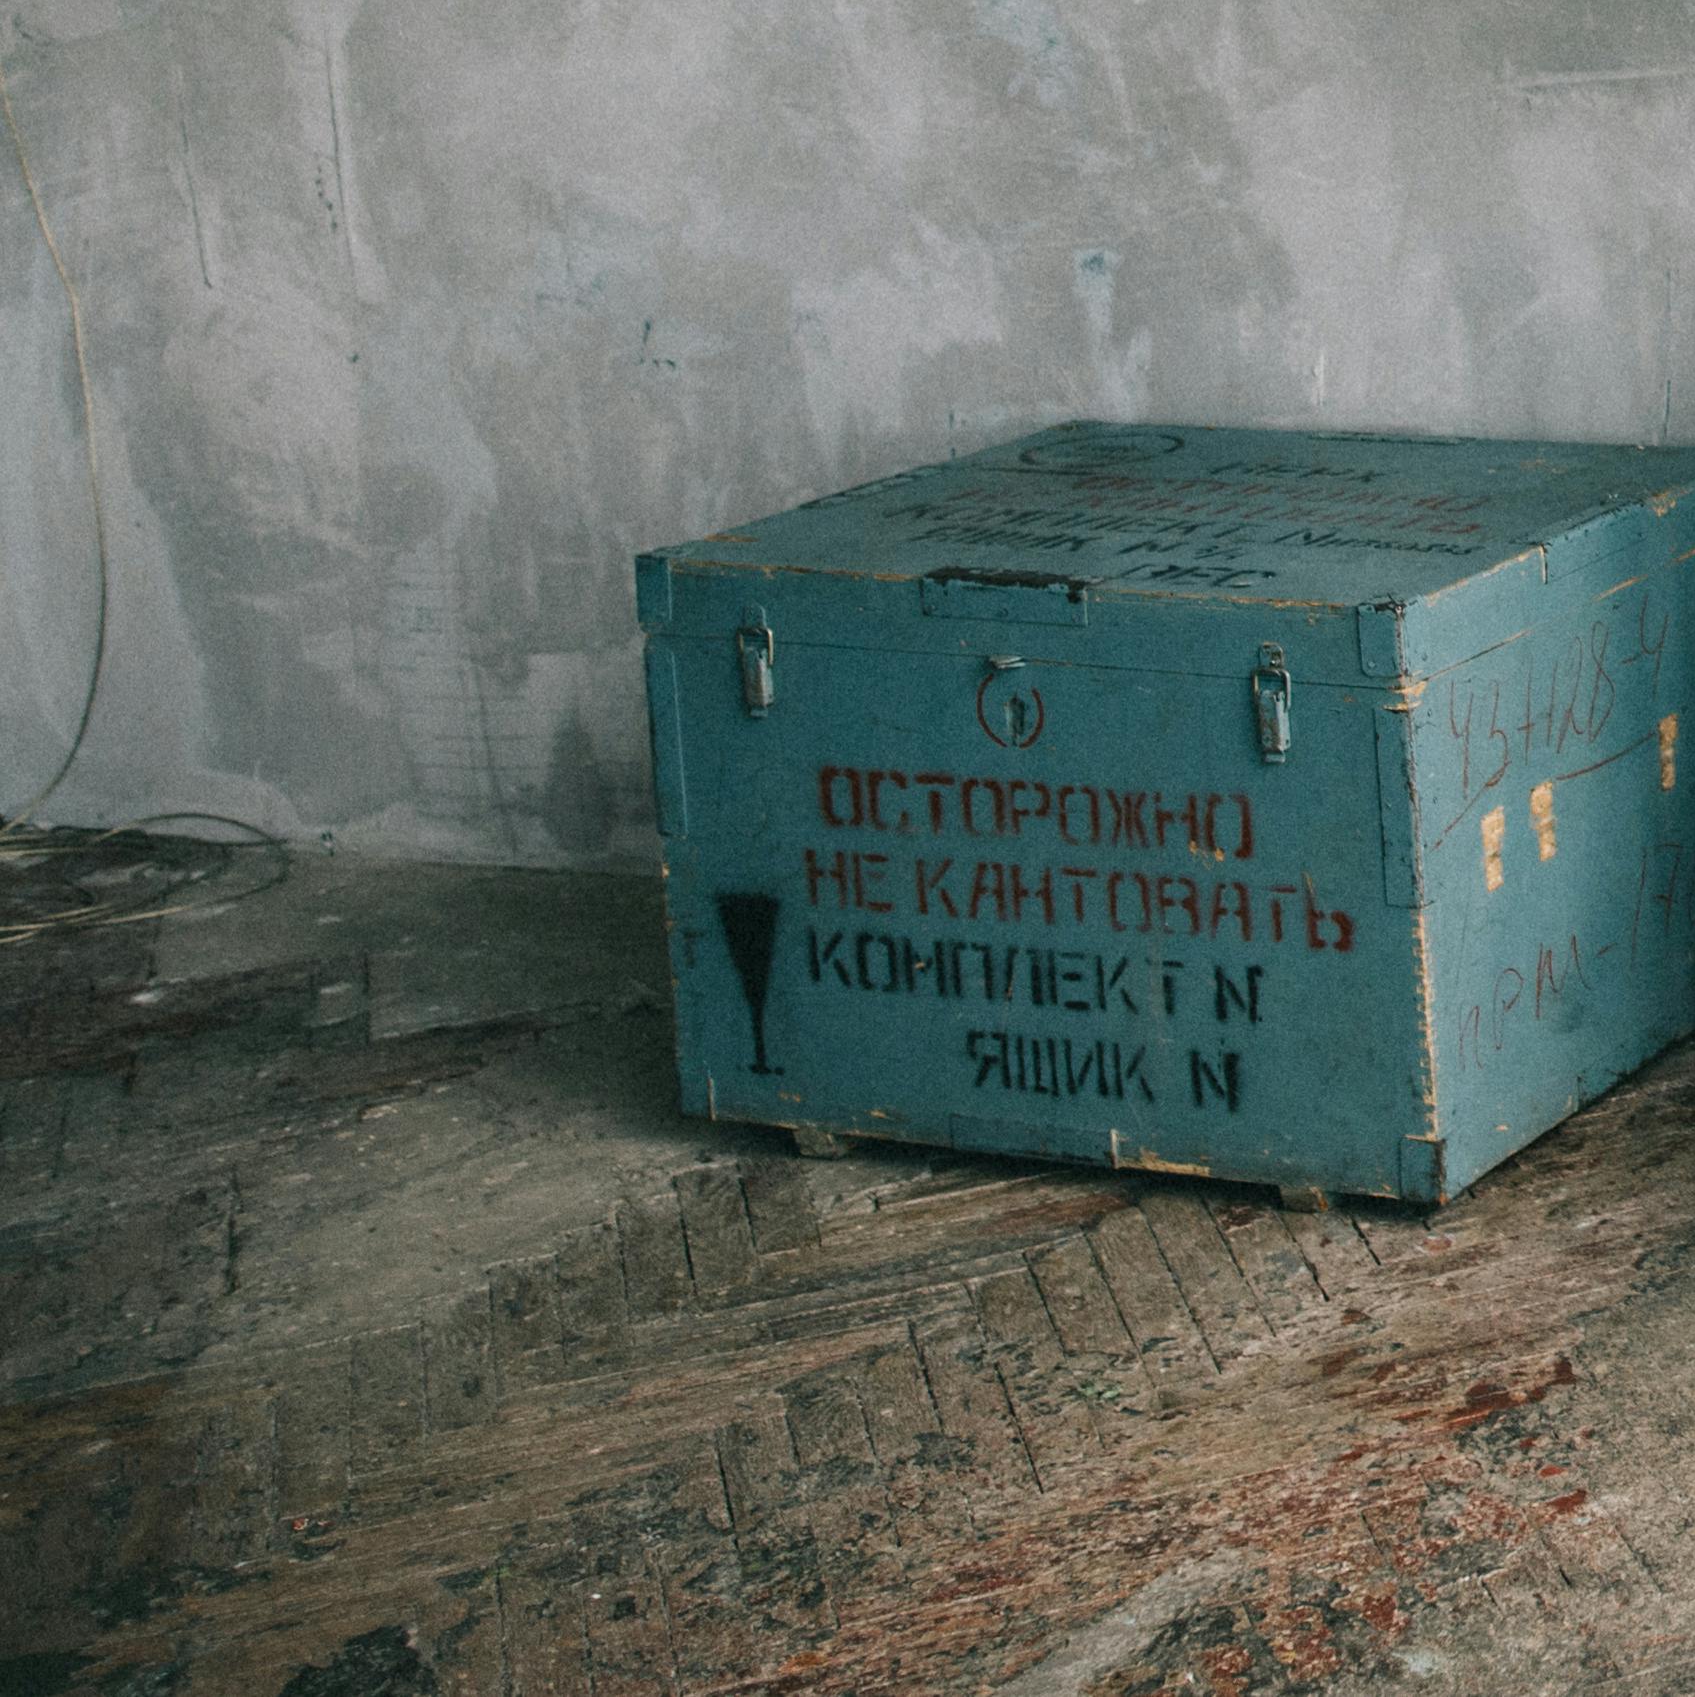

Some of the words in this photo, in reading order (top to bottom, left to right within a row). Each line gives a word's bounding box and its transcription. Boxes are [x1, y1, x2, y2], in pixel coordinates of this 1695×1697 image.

[818, 765, 1252, 859] ОСТОРОЖНО
[805, 847, 894, 911] НЕ
[915, 857, 1354, 951] КАНТОВАТЬ
[807, 926, 1184, 1015] КОМПЛЕКТ
[966, 1030, 1156, 1103] ЯЩИК
